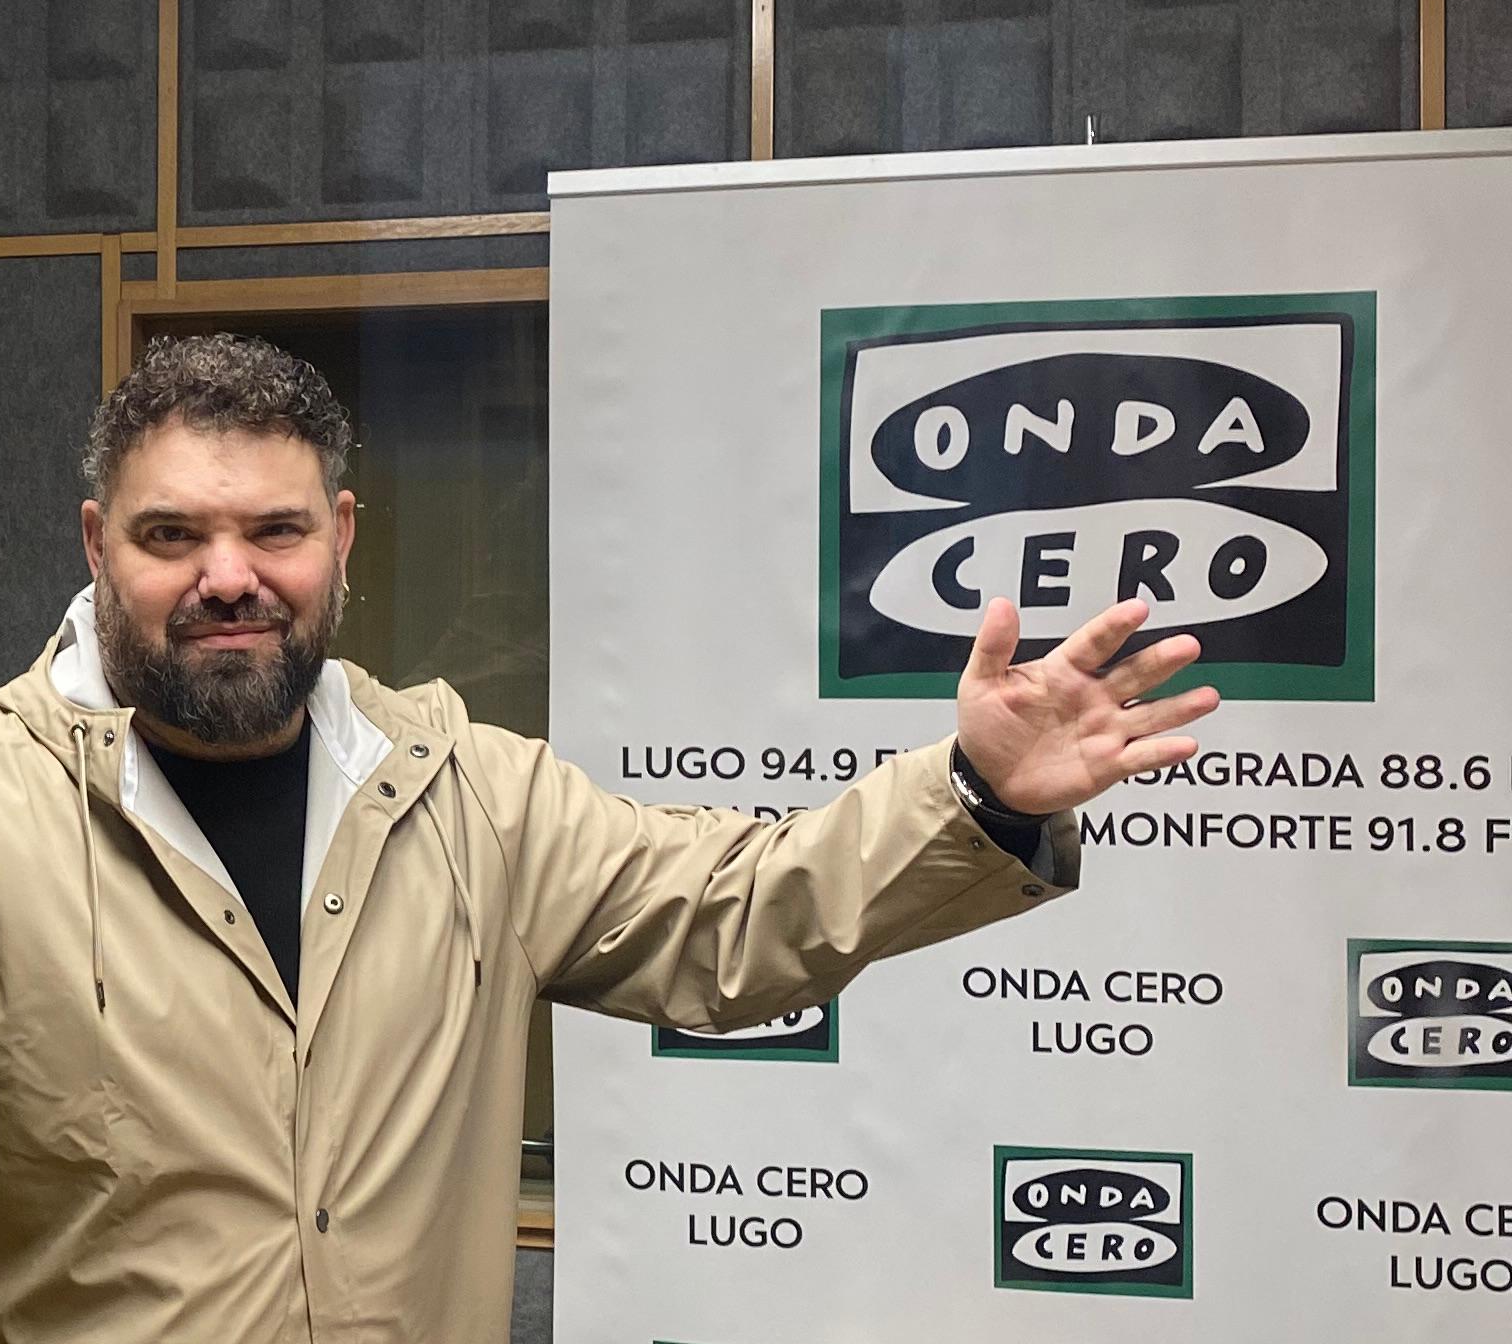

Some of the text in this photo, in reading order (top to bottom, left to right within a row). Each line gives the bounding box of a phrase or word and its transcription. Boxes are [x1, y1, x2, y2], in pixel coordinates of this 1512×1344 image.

[913, 396, 1265, 471] ONDA
[931, 529, 1268, 610] CERO
[621, 746, 746, 781] LUGO
[760, 747, 859, 782] 94.9
[1379, 754, 1492, 790] 88.6
[1080, 811, 1352, 850] MONFORTE
[1367, 816, 1467, 853] 91.8
[962, 966, 1224, 1006] ONDA CERO
[1381, 976, 1512, 1004] ONDA
[1032, 1021, 1154, 1056] LUGO
[1390, 1026, 1512, 1056] CERO
[625, 1159, 869, 1201] ONDA CERO
[1027, 1182, 1155, 1209] ONDA
[688, 1213, 804, 1249] LUGO
[1316, 1196, 1452, 1236] ONDA
[1034, 1232, 1156, 1262] CERO
[1390, 1255, 1512, 1292] LUGO
